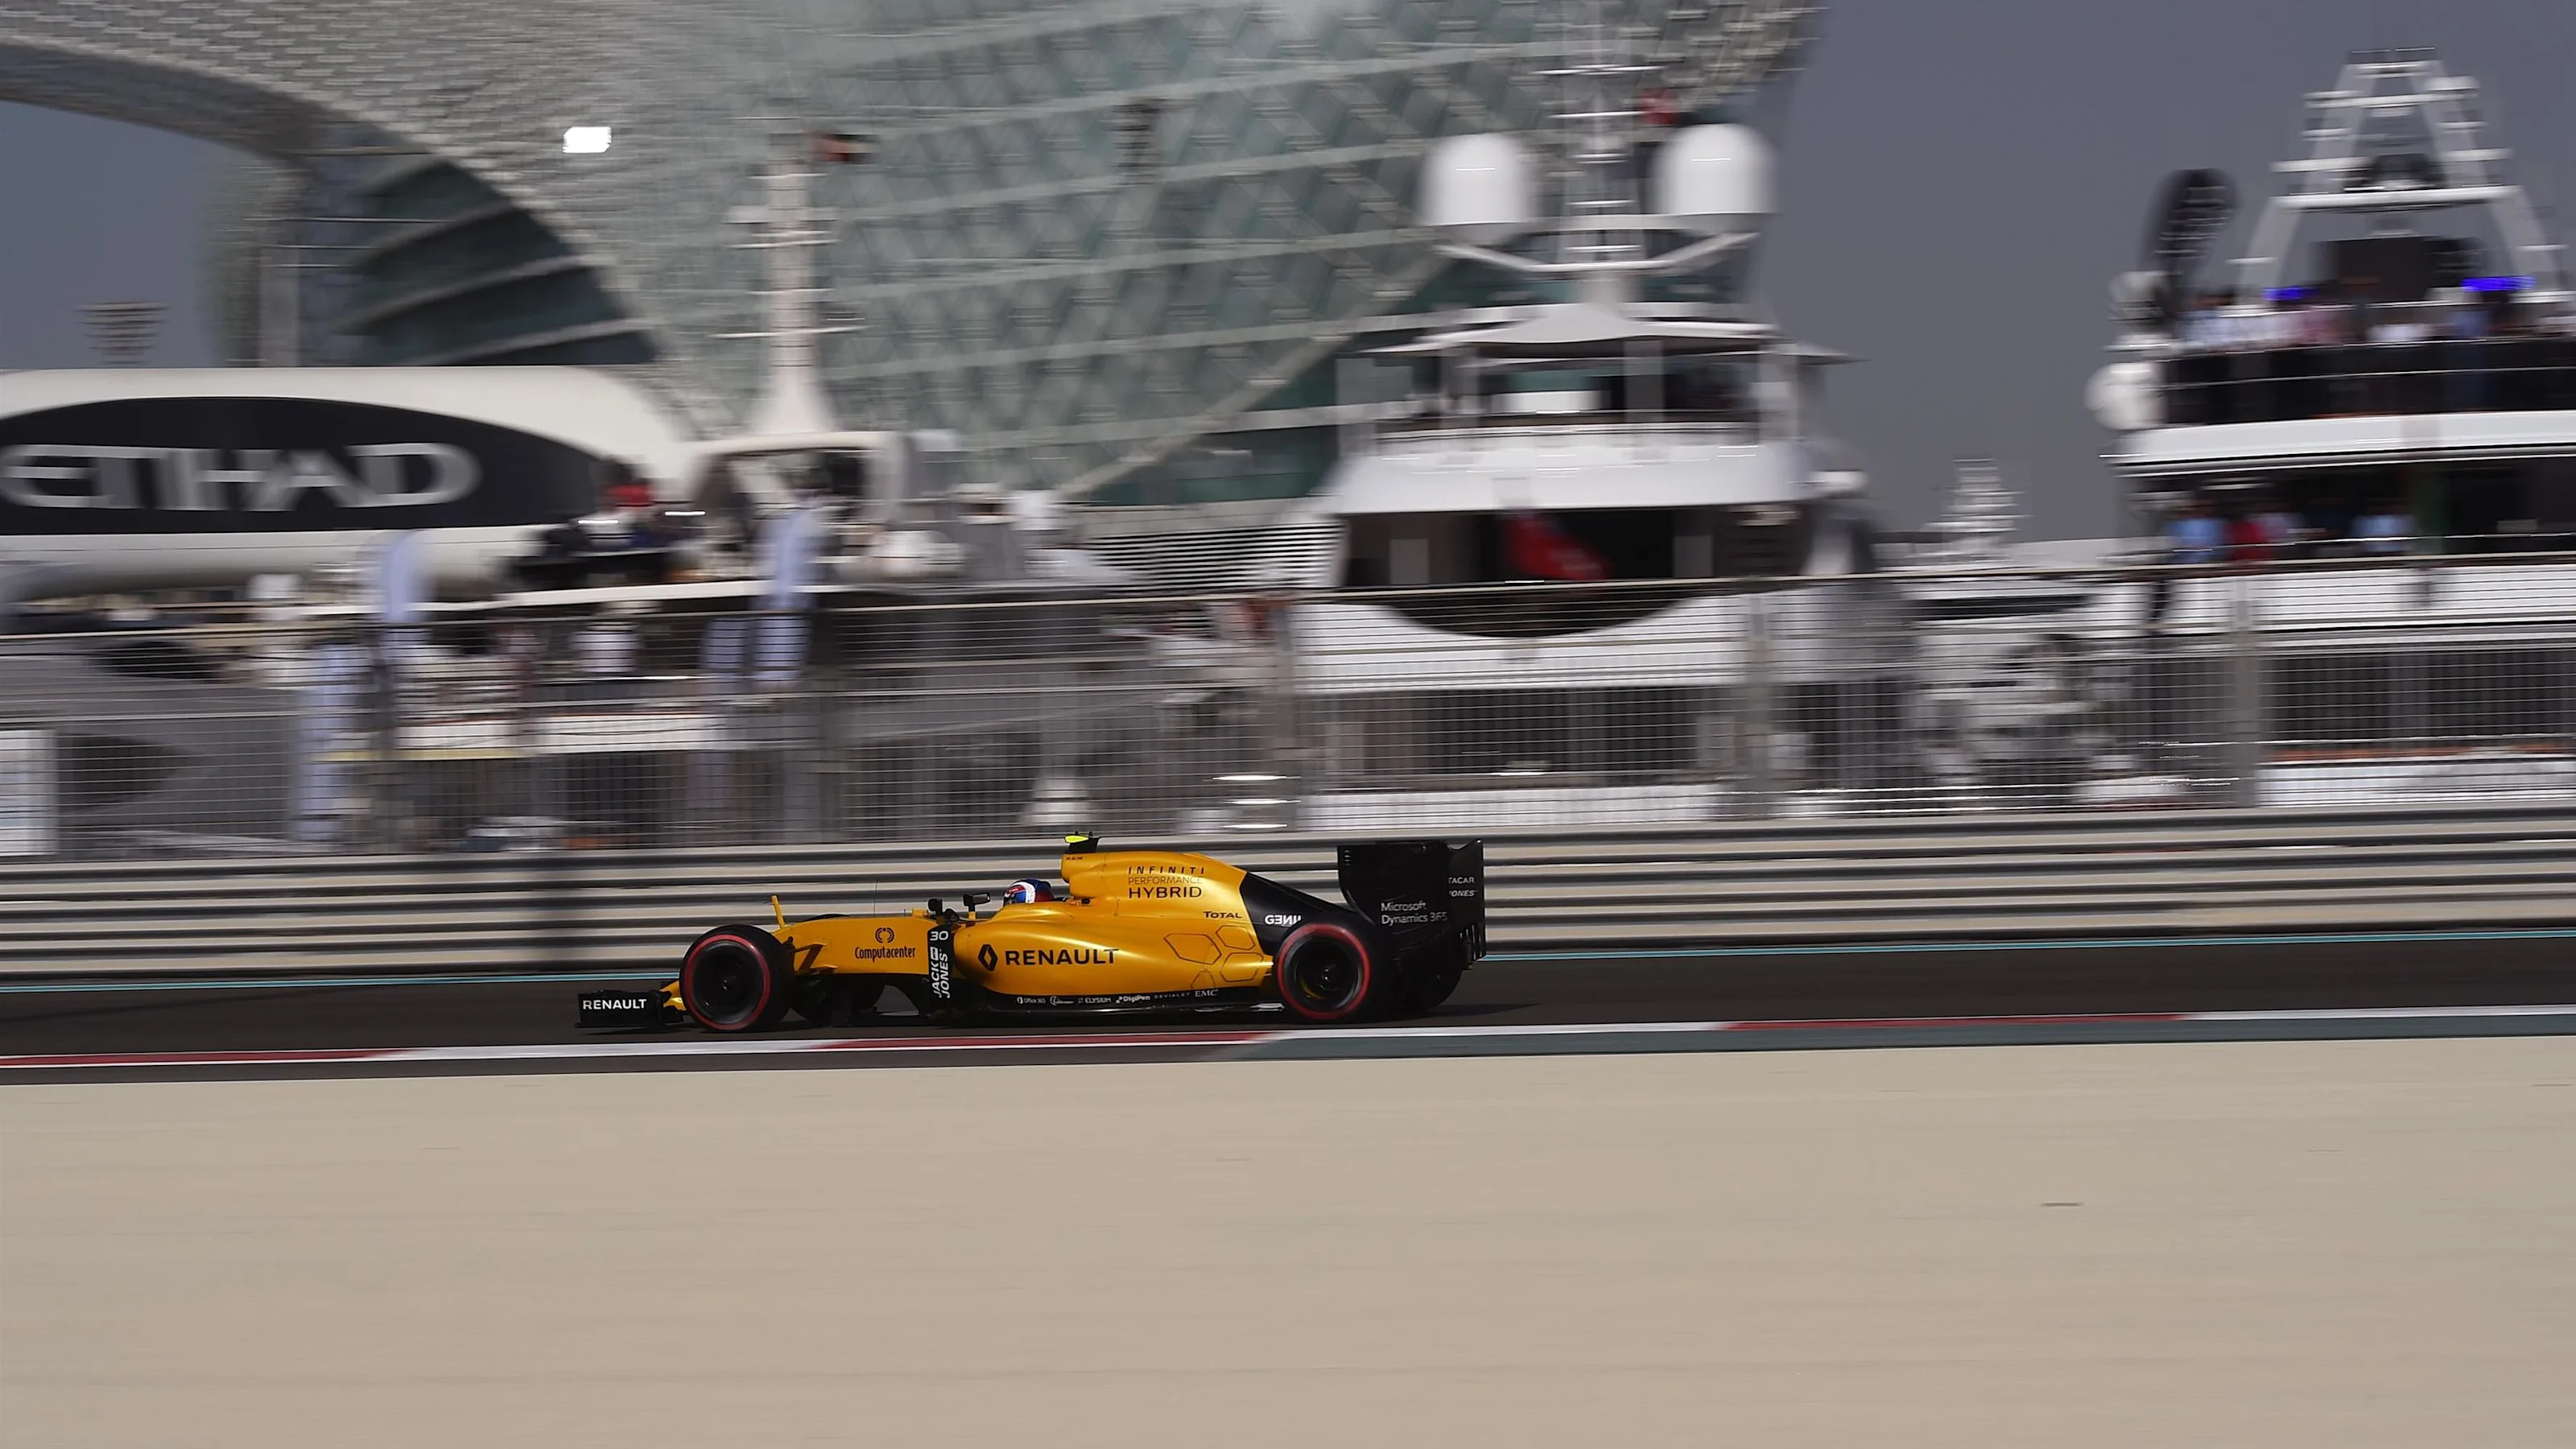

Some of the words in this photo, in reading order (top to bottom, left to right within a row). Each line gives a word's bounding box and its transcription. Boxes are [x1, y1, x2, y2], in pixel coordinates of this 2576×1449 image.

[2, 444, 481, 511] ETIHAD
[1129, 866, 1204, 874] INFINITI
[1129, 876, 1203, 885] PERFORMANCE
[1129, 886, 1202, 898] HYBRID
[1381, 900, 1426, 911] Microsoft
[1381, 913, 1428, 927] Dynamics
[1430, 911, 1448, 922] 365
[930, 931, 948, 941] 30
[855, 945, 916, 963] Computacenter
[1005, 948, 1119, 966] RENAULT
[931, 961, 942, 998] JACK
[939, 952, 951, 998] JONES
[582, 998, 647, 1010] RENAULT
[1123, 995, 1150, 1003] DigiPen
